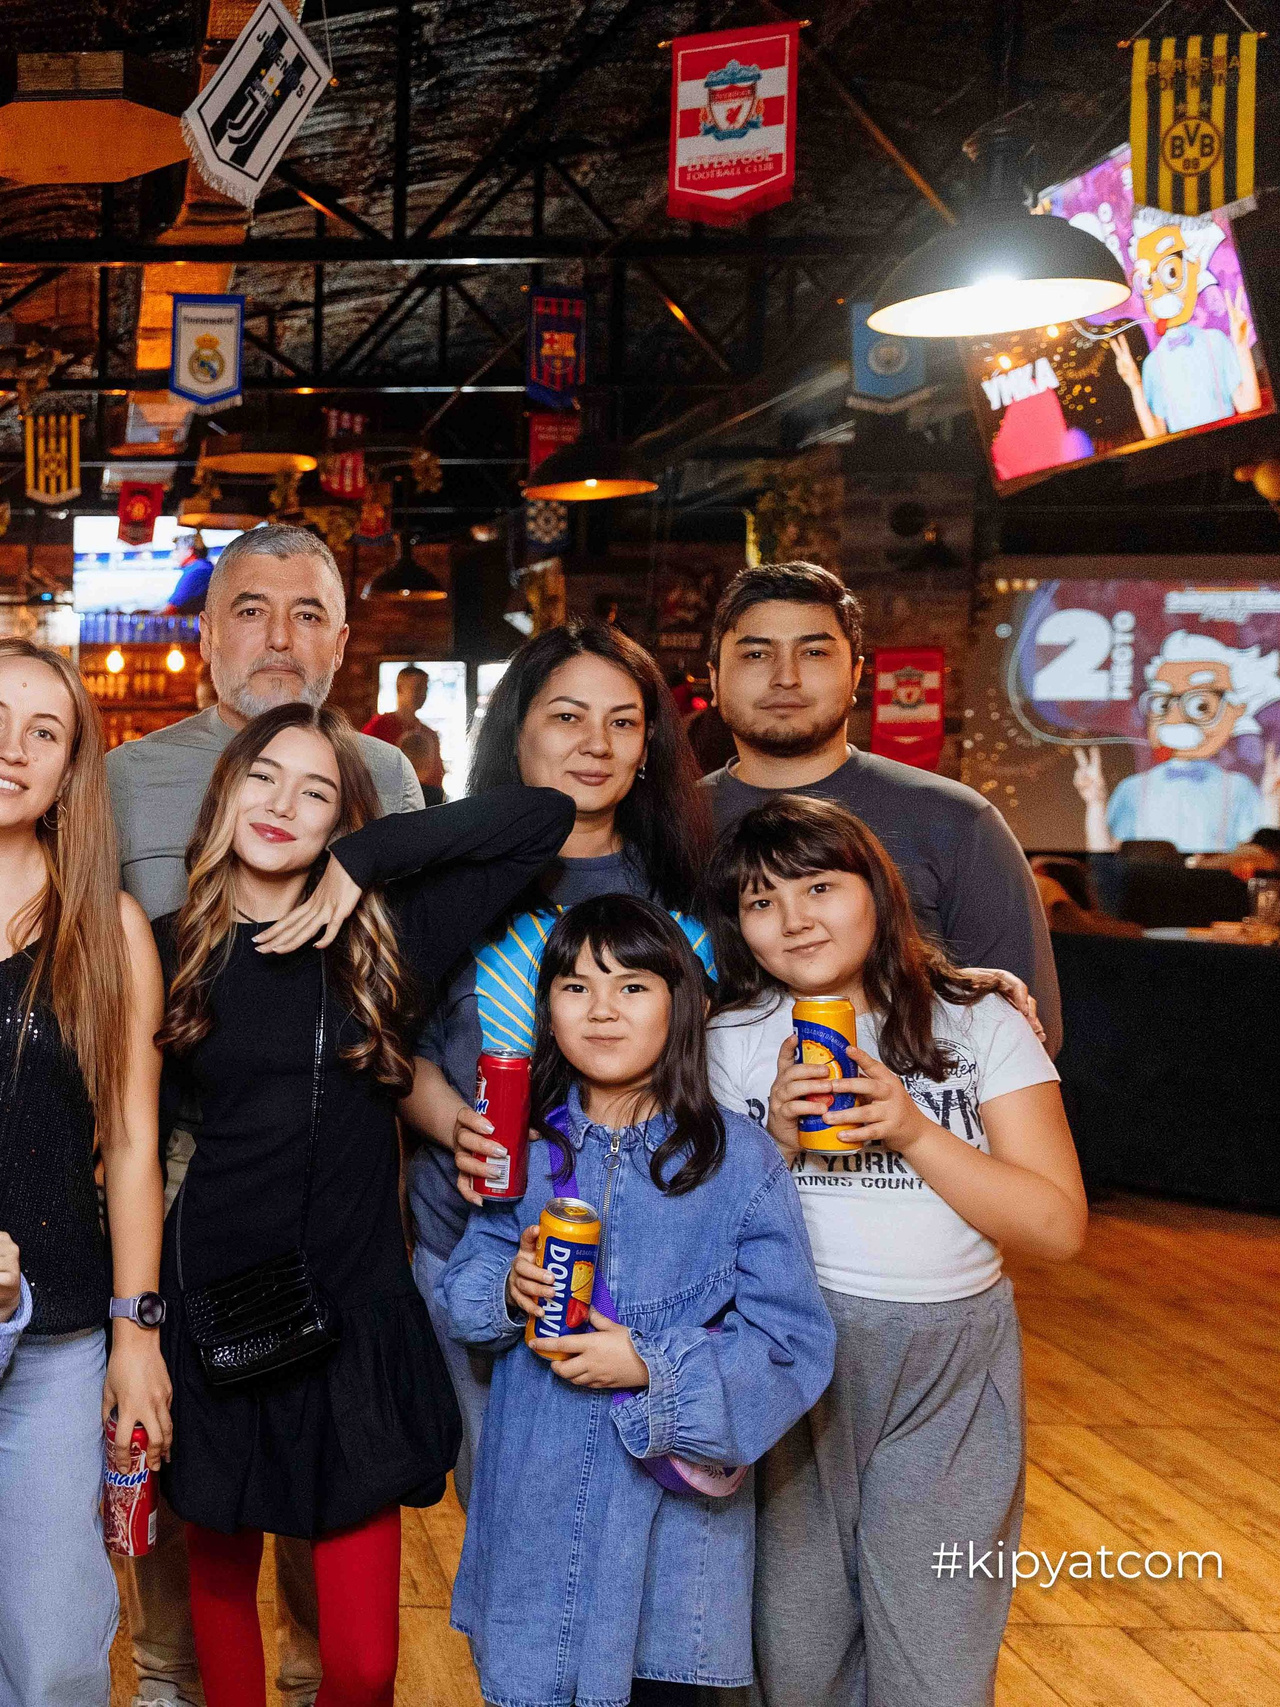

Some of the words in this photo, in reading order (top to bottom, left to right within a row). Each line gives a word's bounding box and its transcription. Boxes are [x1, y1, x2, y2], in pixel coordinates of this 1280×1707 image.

[1171, 123, 1214, 158] BVB
[1034, 608, 1112, 700] 2
[861, 1177, 926, 1190] COUNT
